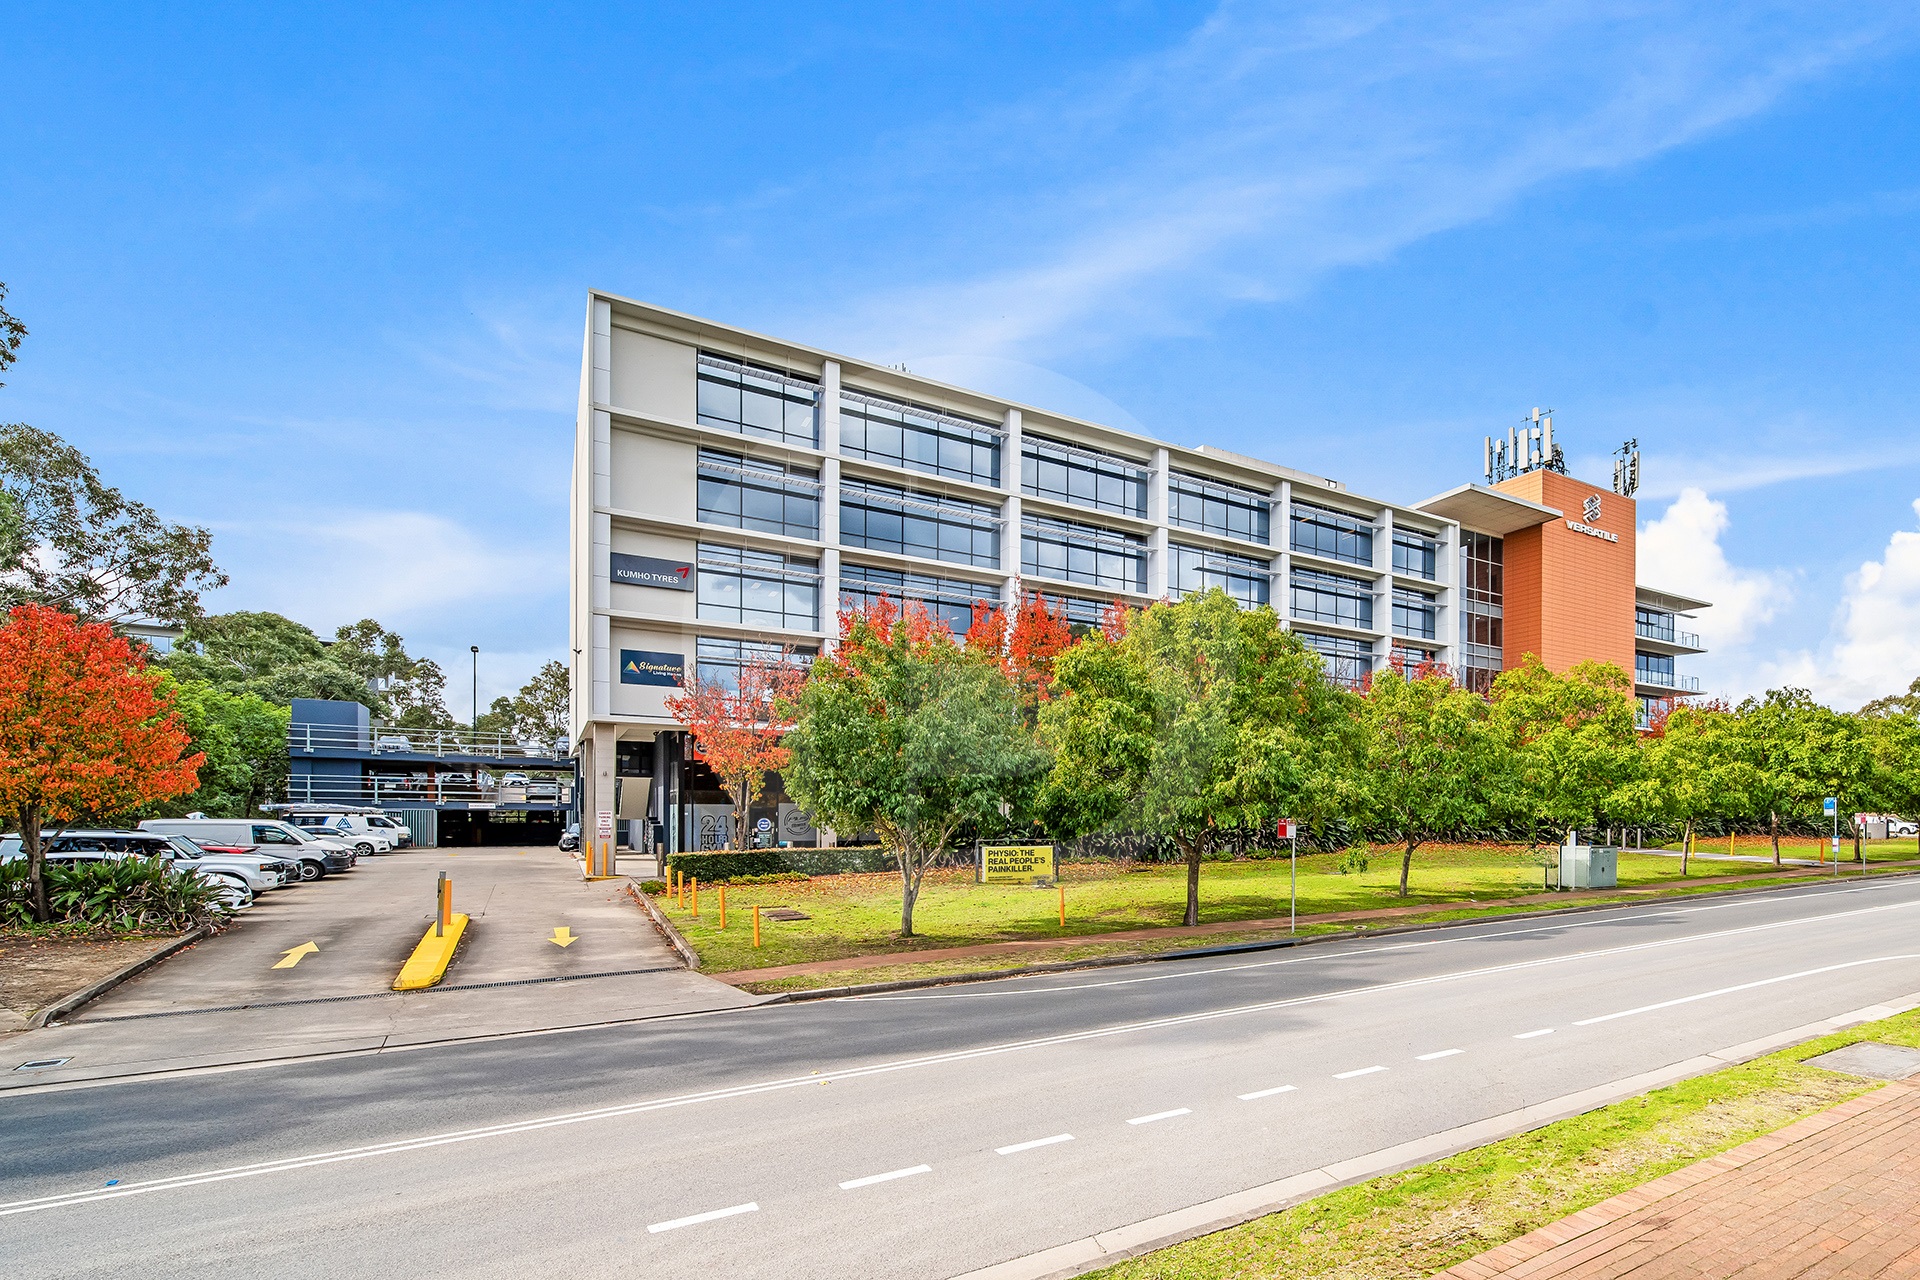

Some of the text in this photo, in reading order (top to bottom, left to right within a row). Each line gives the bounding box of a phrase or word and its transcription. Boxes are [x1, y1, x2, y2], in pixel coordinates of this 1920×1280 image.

[1565, 519, 1619, 543] VERSATILE
[617, 569, 679, 584] KUMHO TYRES
[639, 661, 682, 673] Signature
[701, 815, 728, 835] 24
[701, 835, 728, 844] HOUR
[988, 865, 1034, 873] PAINKILLER.
